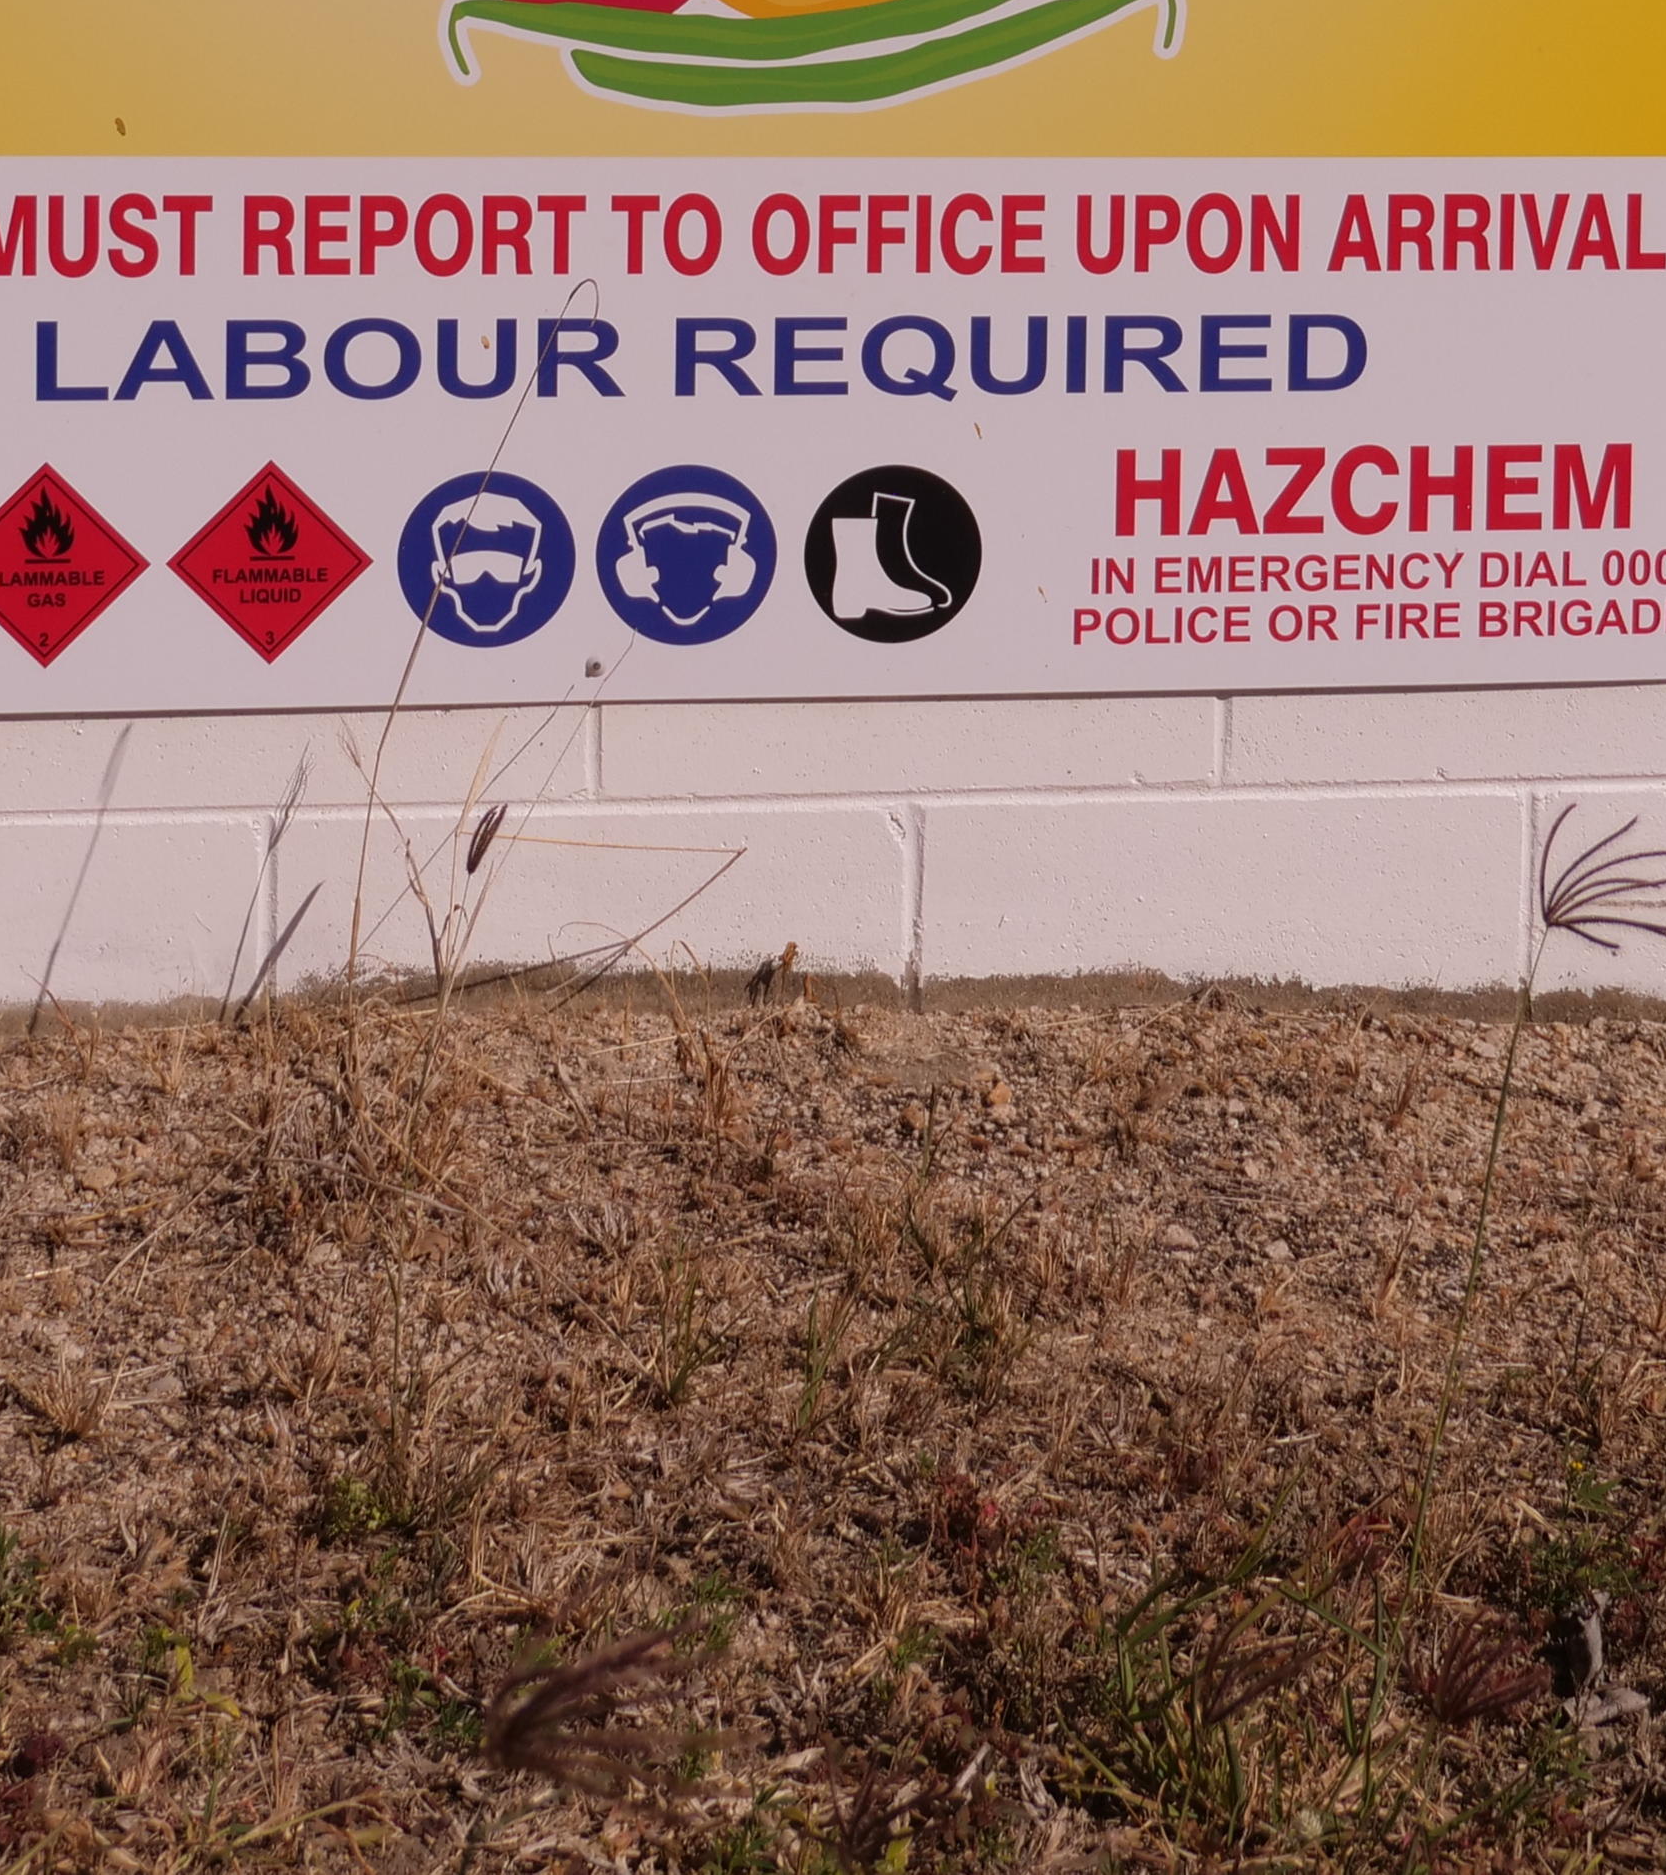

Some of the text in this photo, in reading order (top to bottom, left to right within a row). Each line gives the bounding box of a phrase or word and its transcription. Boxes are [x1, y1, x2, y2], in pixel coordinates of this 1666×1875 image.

[242, 192, 588, 278] REPORT
[611, 192, 723, 277] TO
[751, 192, 1047, 277] OFFICE
[1076, 192, 1302, 276] UPON
[35, 317, 624, 403] LABOUR
[674, 314, 1368, 402] REQUIRED
[1115, 442, 1634, 537] HAZCHEM
[212, 567, 328, 584] FLAMMABLE
[1091, 557, 1135, 595] IN
[1154, 551, 1464, 594] EMERGENCY
[1479, 550, 1588, 589] DIAL
[26, 592, 66, 608] GAS
[239, 588, 302, 604] LIQUID
[265, 631, 275, 646] 3
[1073, 605, 1251, 645] POLICE
[1268, 603, 1338, 643] OR
[1355, 602, 1461, 640] FIRE
[39, 632, 49, 647] 2
